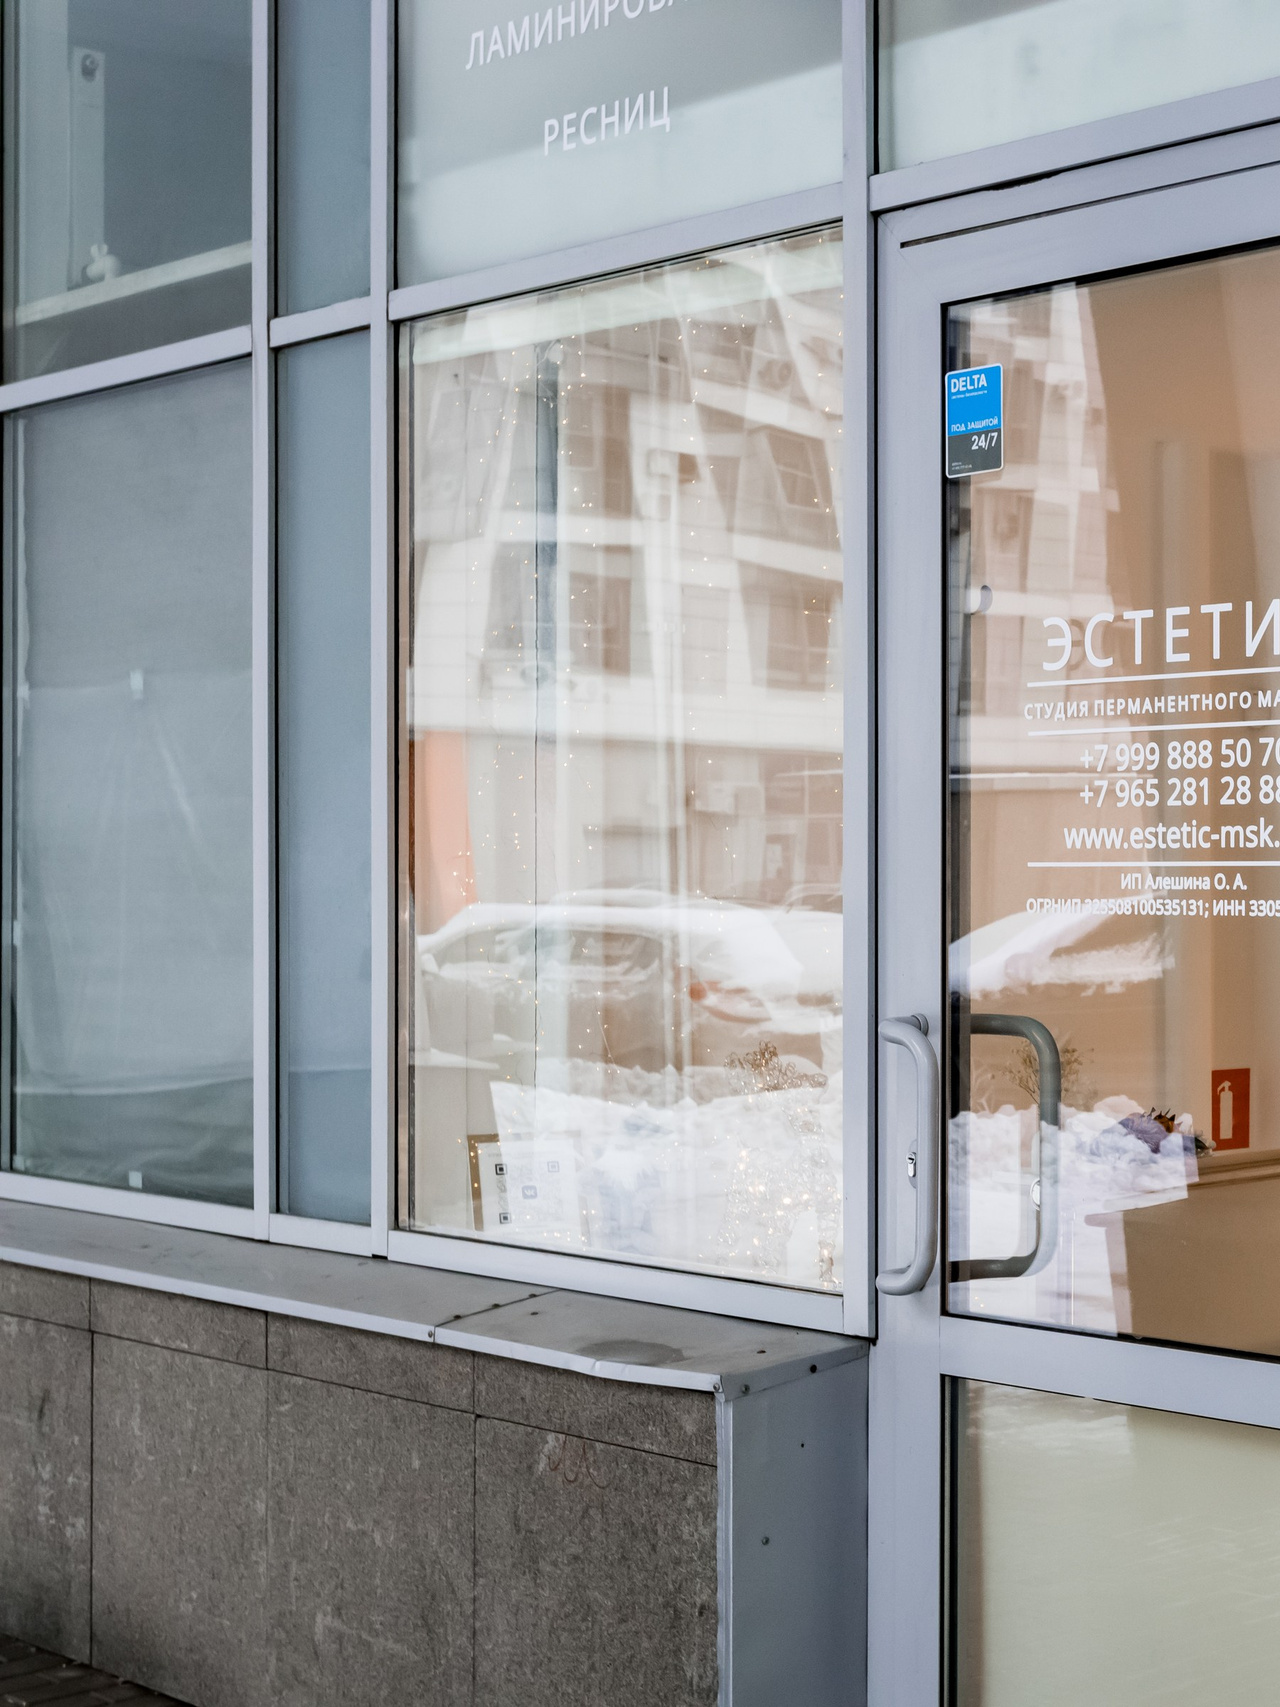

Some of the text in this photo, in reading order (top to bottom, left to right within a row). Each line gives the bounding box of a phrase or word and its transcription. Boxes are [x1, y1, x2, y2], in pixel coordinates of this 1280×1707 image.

[465, 0, 675, 70] ЛАМИНИРО
[543, 86, 671, 156] РЕСНИЦ
[951, 373, 987, 392] DELTA
[951, 416, 998, 433] ПОД ЗАЩИТОЙ
[971, 432, 998, 451] 24/7
[1023, 700, 1089, 722] СТУДИЯ
[1094, 691, 1252, 716] ПЕРМАНЕНТНОГО
[1080, 744, 1109, 772] +7
[1115, 741, 1160, 772] 999
[1167, 739, 1213, 770] 888
[1220, 737, 1252, 768] 50
[1080, 779, 1109, 808] +7
[1115, 778, 1160, 808] 965
[1166, 777, 1209, 807] 281
[1219, 775, 1252, 805] 28
[1120, 872, 1248, 891] ИП Алешина О. А.
[1026, 897, 1081, 914] ОГРНИП
[1083, 898, 1210, 919] 325508100535131;
[1212, 899, 1246, 916] ИНН
